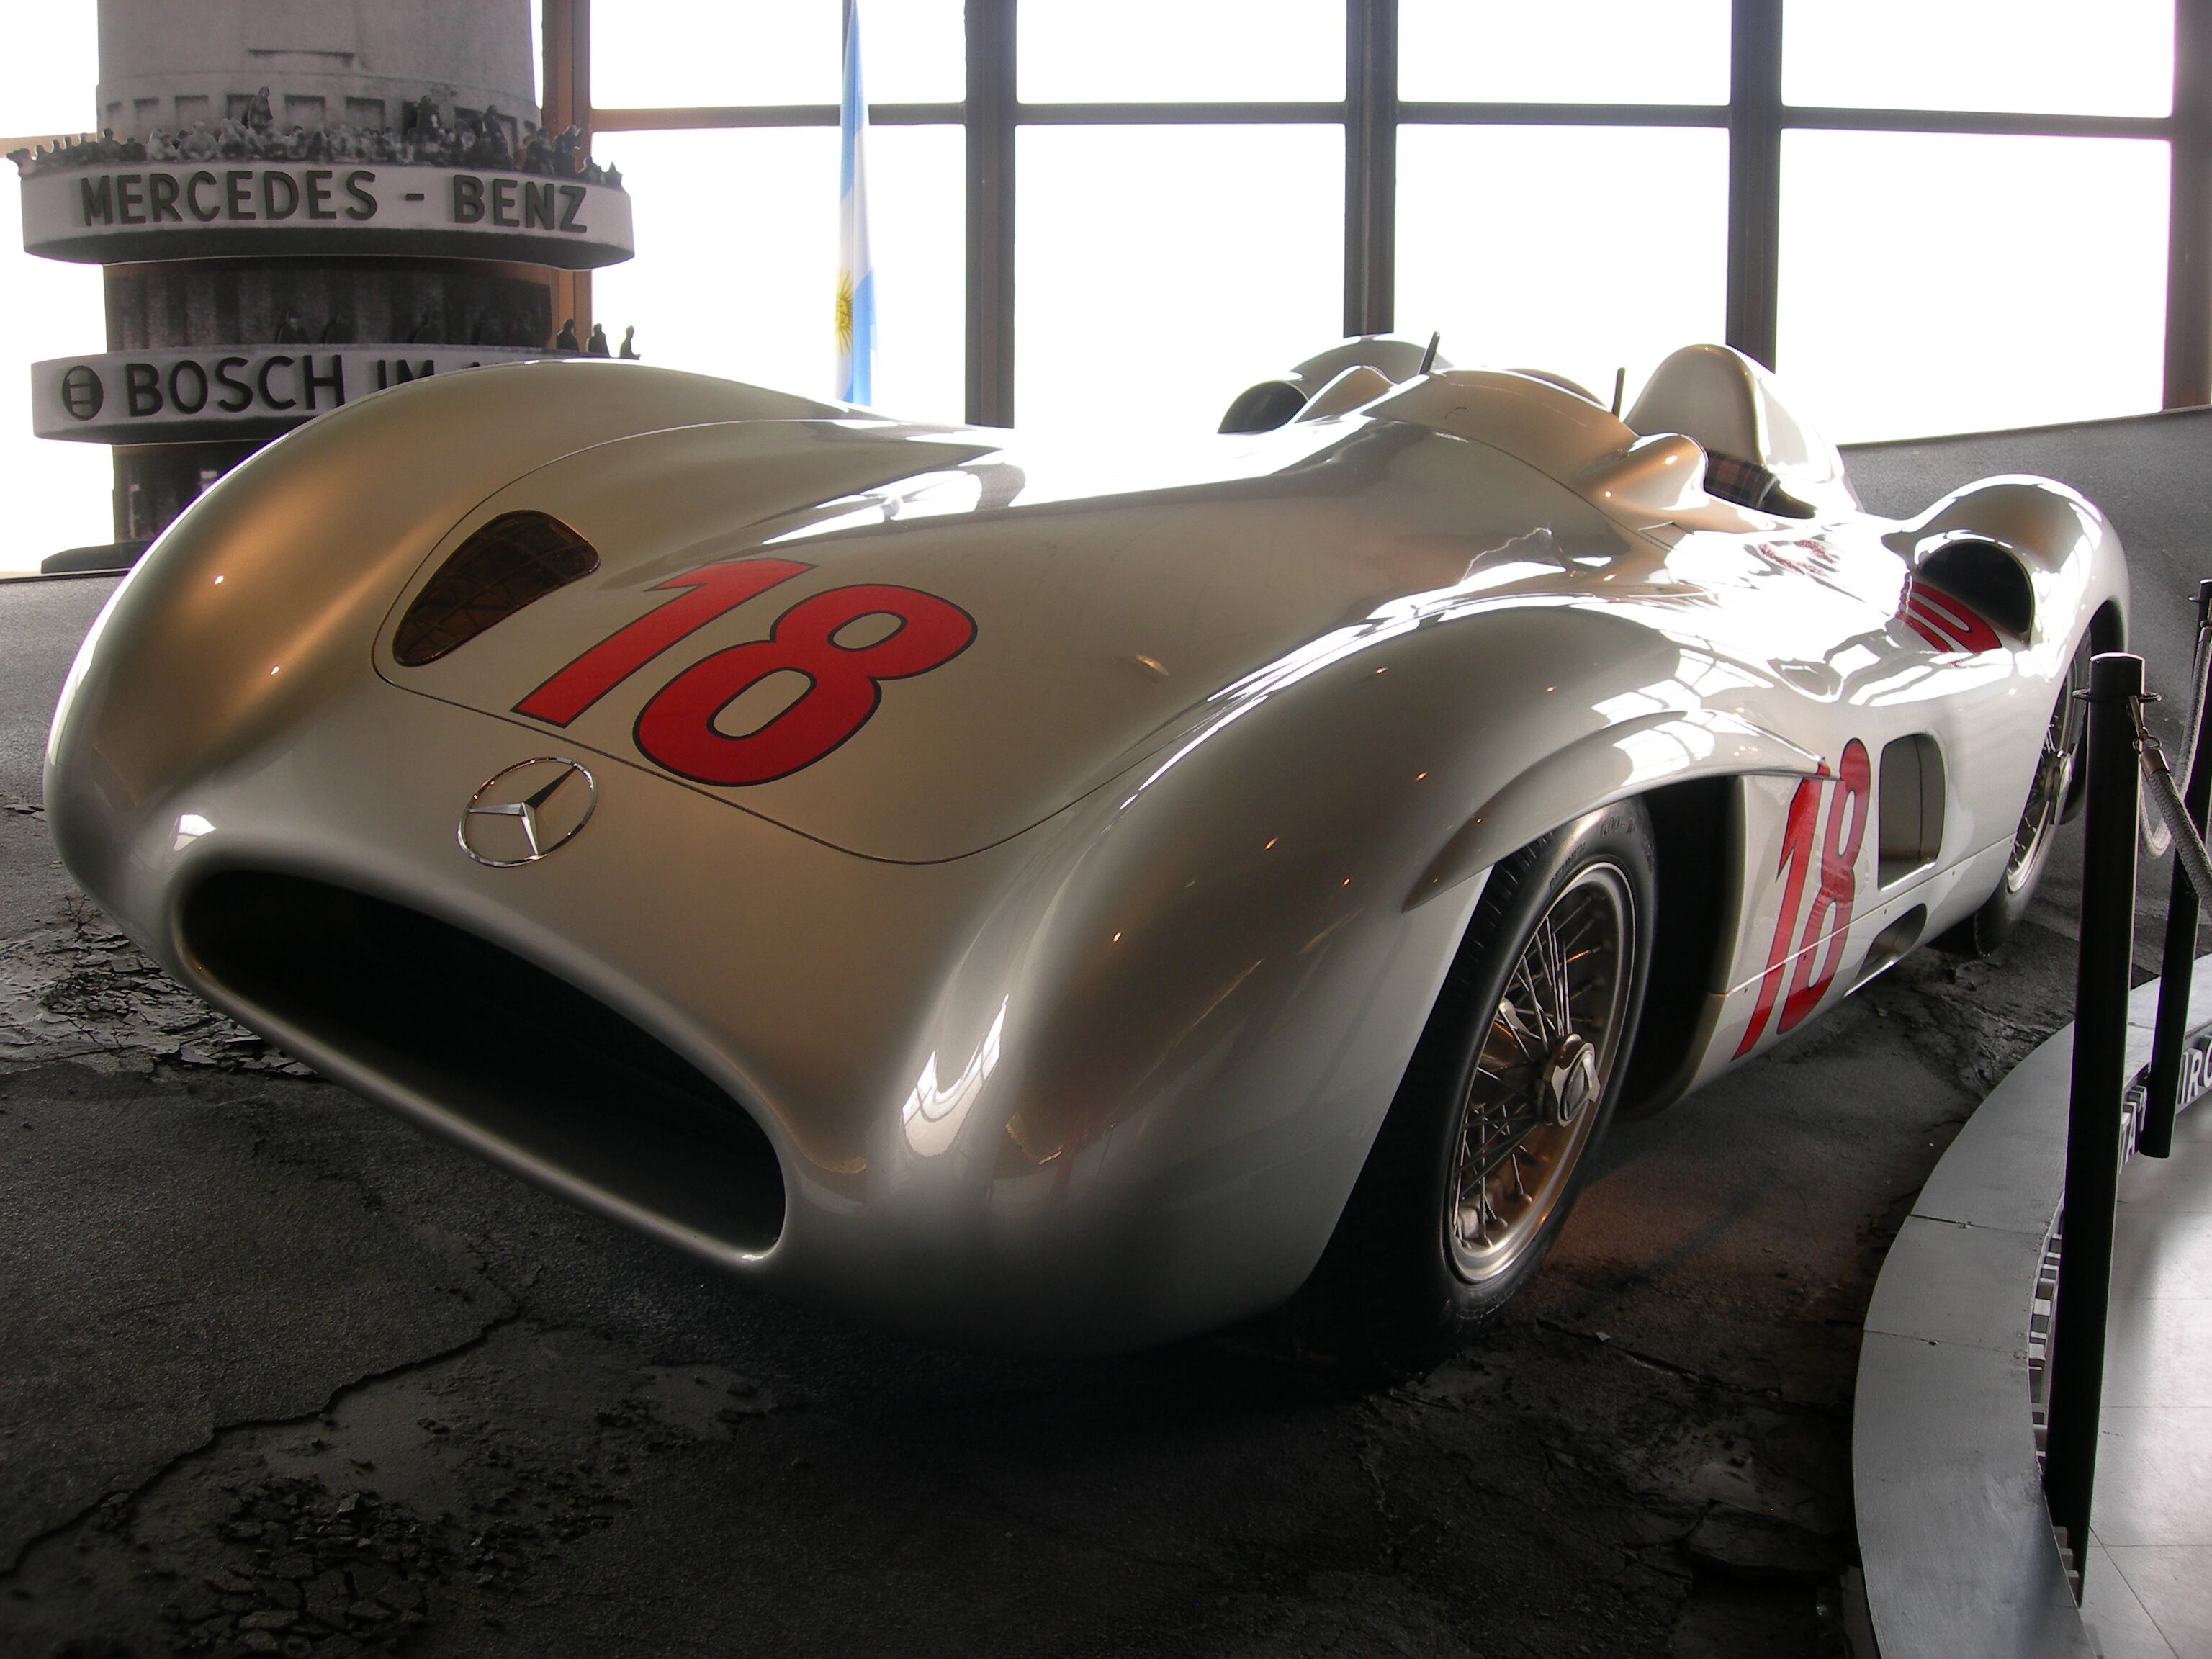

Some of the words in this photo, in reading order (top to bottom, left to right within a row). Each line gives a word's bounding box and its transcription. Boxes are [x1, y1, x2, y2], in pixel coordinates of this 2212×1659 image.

[81, 170, 379, 226] MERCEDES
[453, 174, 589, 233] BENZ
[125, 354, 346, 416] BOSCH
[510, 557, 978, 787] 18
[1732, 737, 1872, 1061] 18
